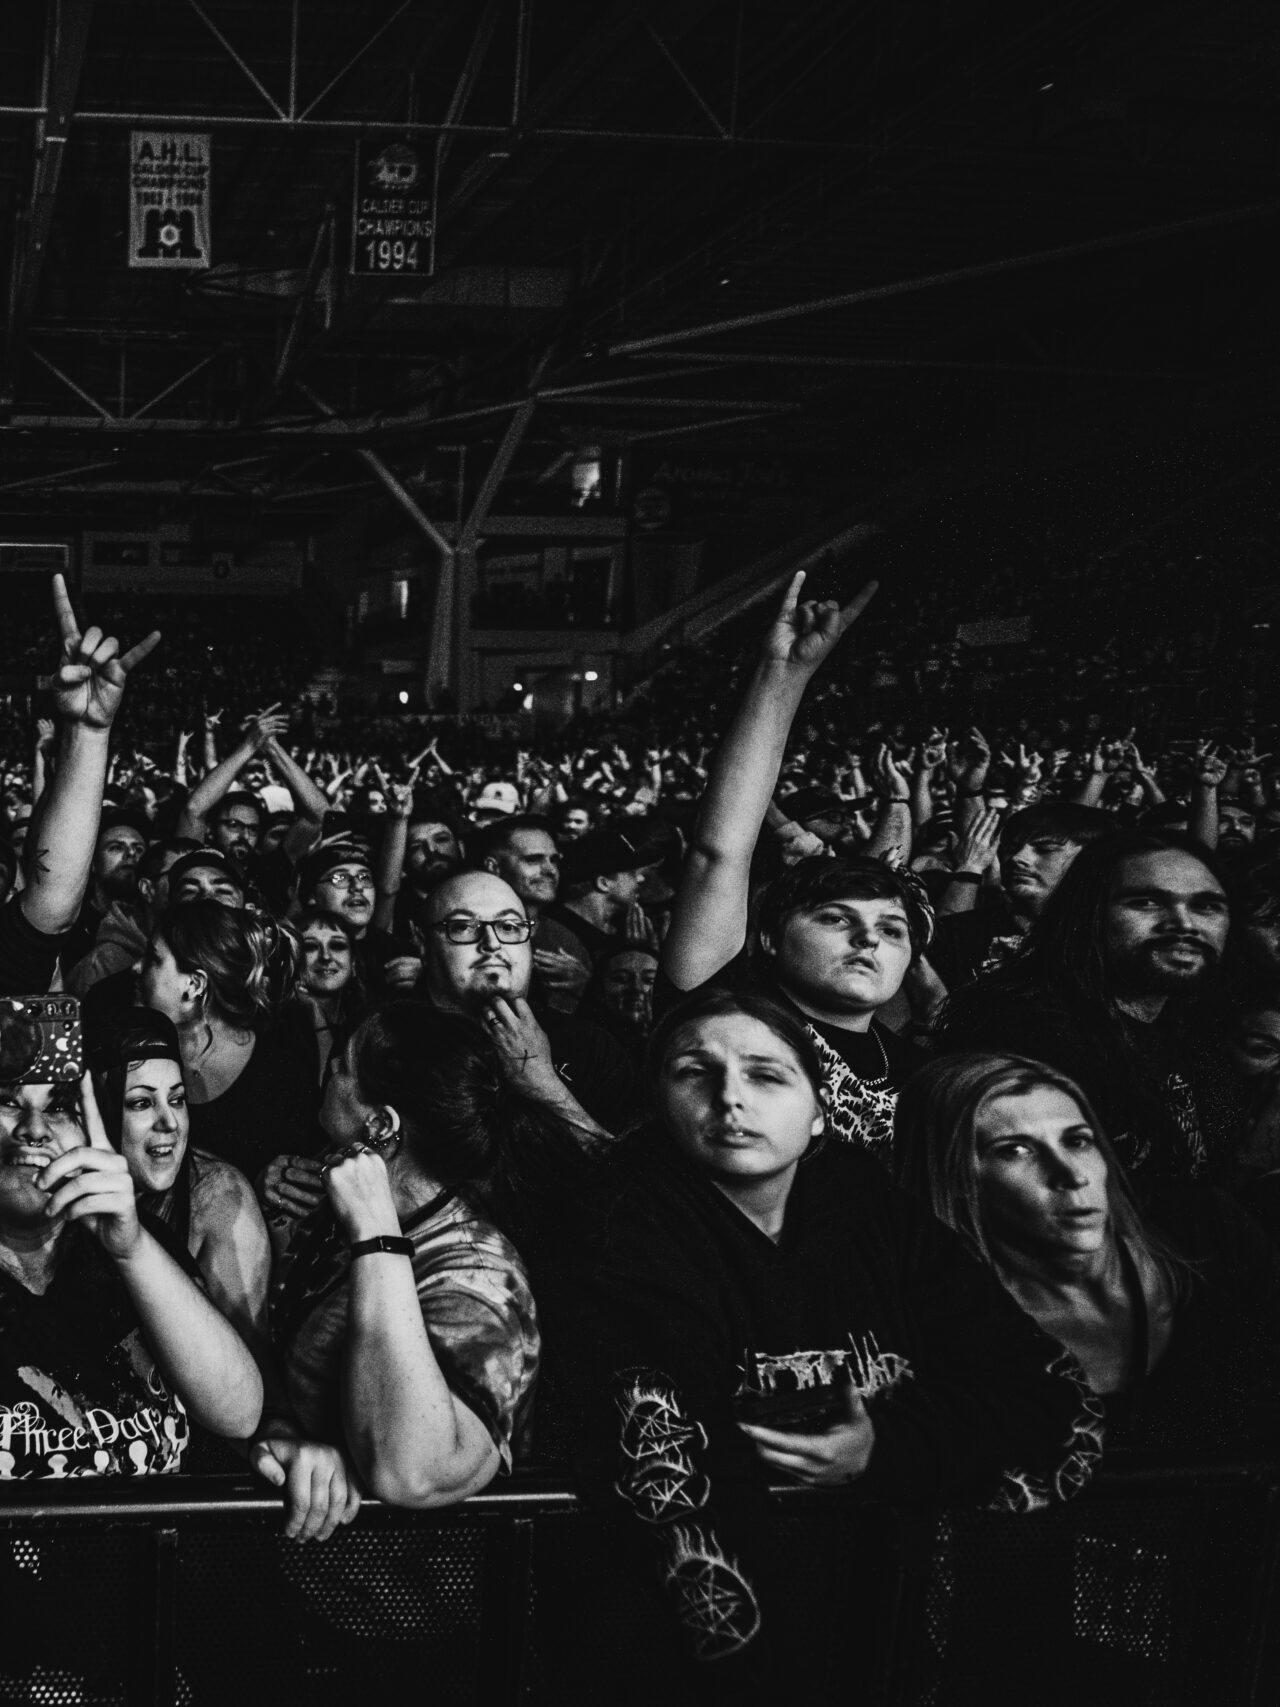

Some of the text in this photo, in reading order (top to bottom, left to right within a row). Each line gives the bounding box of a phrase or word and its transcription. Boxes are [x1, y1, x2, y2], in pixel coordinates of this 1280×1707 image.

[139, 141, 203, 163] A.H.L.
[133, 175, 207, 190] CHAMPIONS
[362, 198, 406, 215] CALDER
[358, 219, 433, 238] CHAMPIONS
[365, 240, 419, 270] 1994
